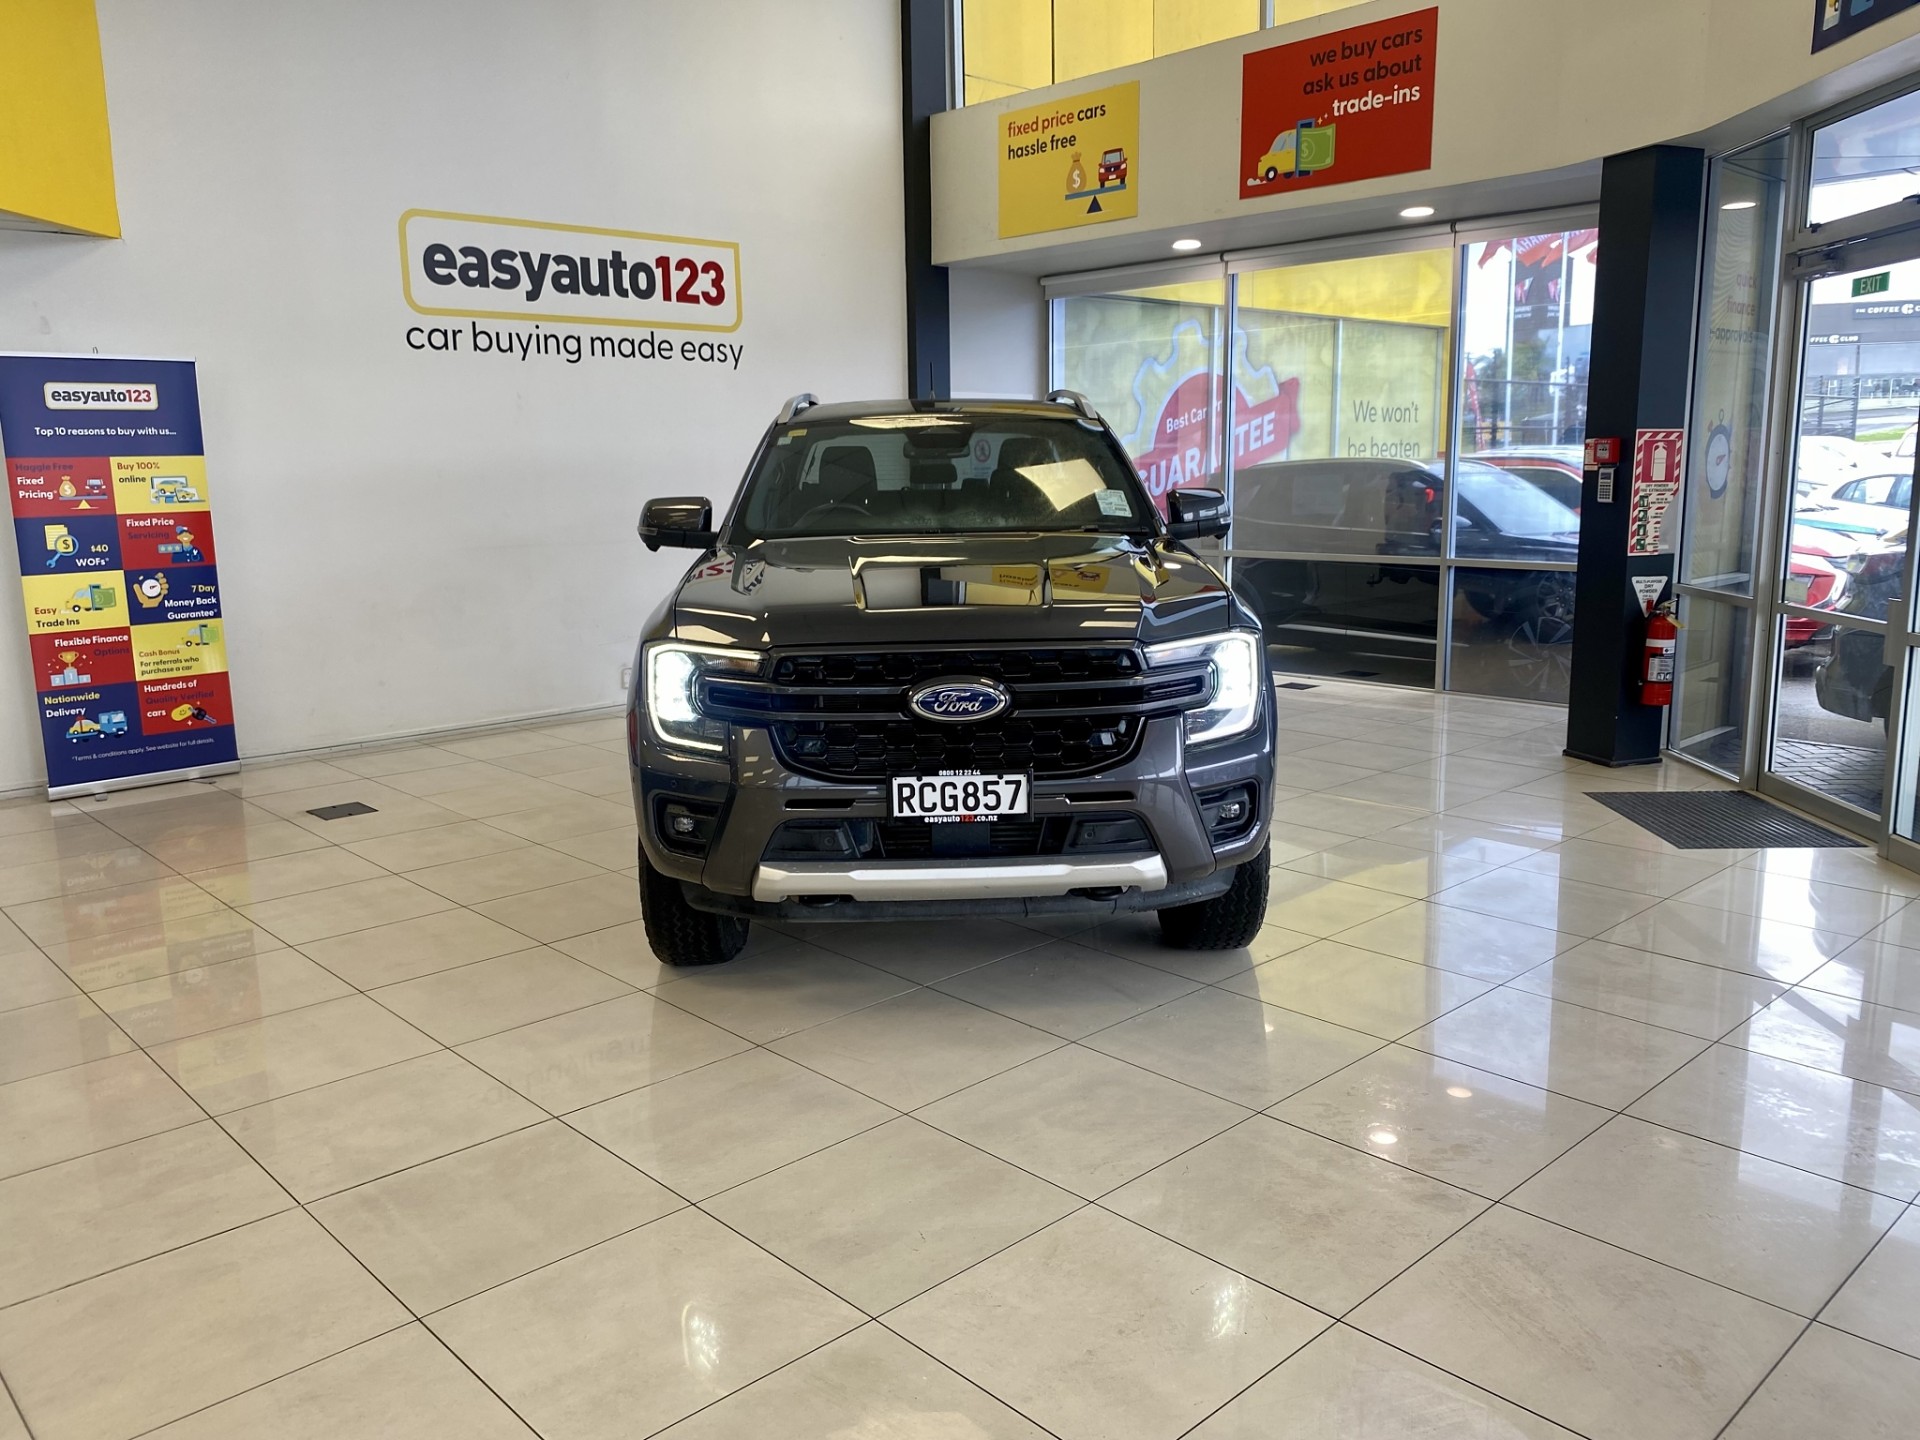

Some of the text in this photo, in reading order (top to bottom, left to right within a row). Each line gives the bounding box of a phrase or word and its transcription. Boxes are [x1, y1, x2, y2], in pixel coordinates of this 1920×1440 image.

[1310, 28, 1423, 67] we buy cars
[1303, 54, 1422, 95] ask us about
[1332, 84, 1421, 117] trade-ins
[1007, 104, 1106, 138] fixed price cars
[1007, 134, 1077, 160] hassle free
[422, 243, 726, 307] easyauto123
[1860, 276, 1883, 294] EXIT
[1867, 306, 1900, 314] COFFEE
[406, 321, 744, 371] car buying made easy
[51, 389, 152, 404] easyauto123
[1353, 400, 1419, 423] We won't
[1166, 408, 1207, 434] Best Car
[34, 427, 54, 437] Top
[54, 427, 66, 436] 10
[67, 427, 106, 436] reasons
[106, 427, 116, 436] to
[117, 427, 135, 437] buy
[136, 427, 158, 436] with
[1348, 436, 1420, 458] be beaten
[117, 462, 160, 471] Buy 100%
[17, 477, 44, 485] Fixed
[119, 475, 146, 483] online
[126, 518, 175, 527] Fixed Price
[128, 531, 170, 540] Servicing
[91, 544, 109, 553] $40
[199, 585, 216, 594] Day
[165, 596, 217, 609] Money Back
[34, 607, 57, 616] Easy
[36, 618, 80, 628] Trade Ins
[54, 634, 129, 647] Flexible Finance
[94, 648, 130, 657] Options
[139, 648, 180, 658] Cash Bonus
[140, 660, 152, 668] For
[152, 657, 186, 667] referrals
[141, 666, 174, 676] purchase
[143, 680, 198, 693] Hundreds of
[44, 691, 100, 705] Nationwide
[146, 694, 178, 705] Quality
[934, 690, 983, 713] Ford
[46, 707, 86, 718] Delivery
[147, 709, 166, 717] cars
[98, 749, 127, 758] conditions
[157, 742, 179, 750] website
[897, 780, 1022, 813] RCG857
[924, 815, 998, 824] easyauto123.co.nz
